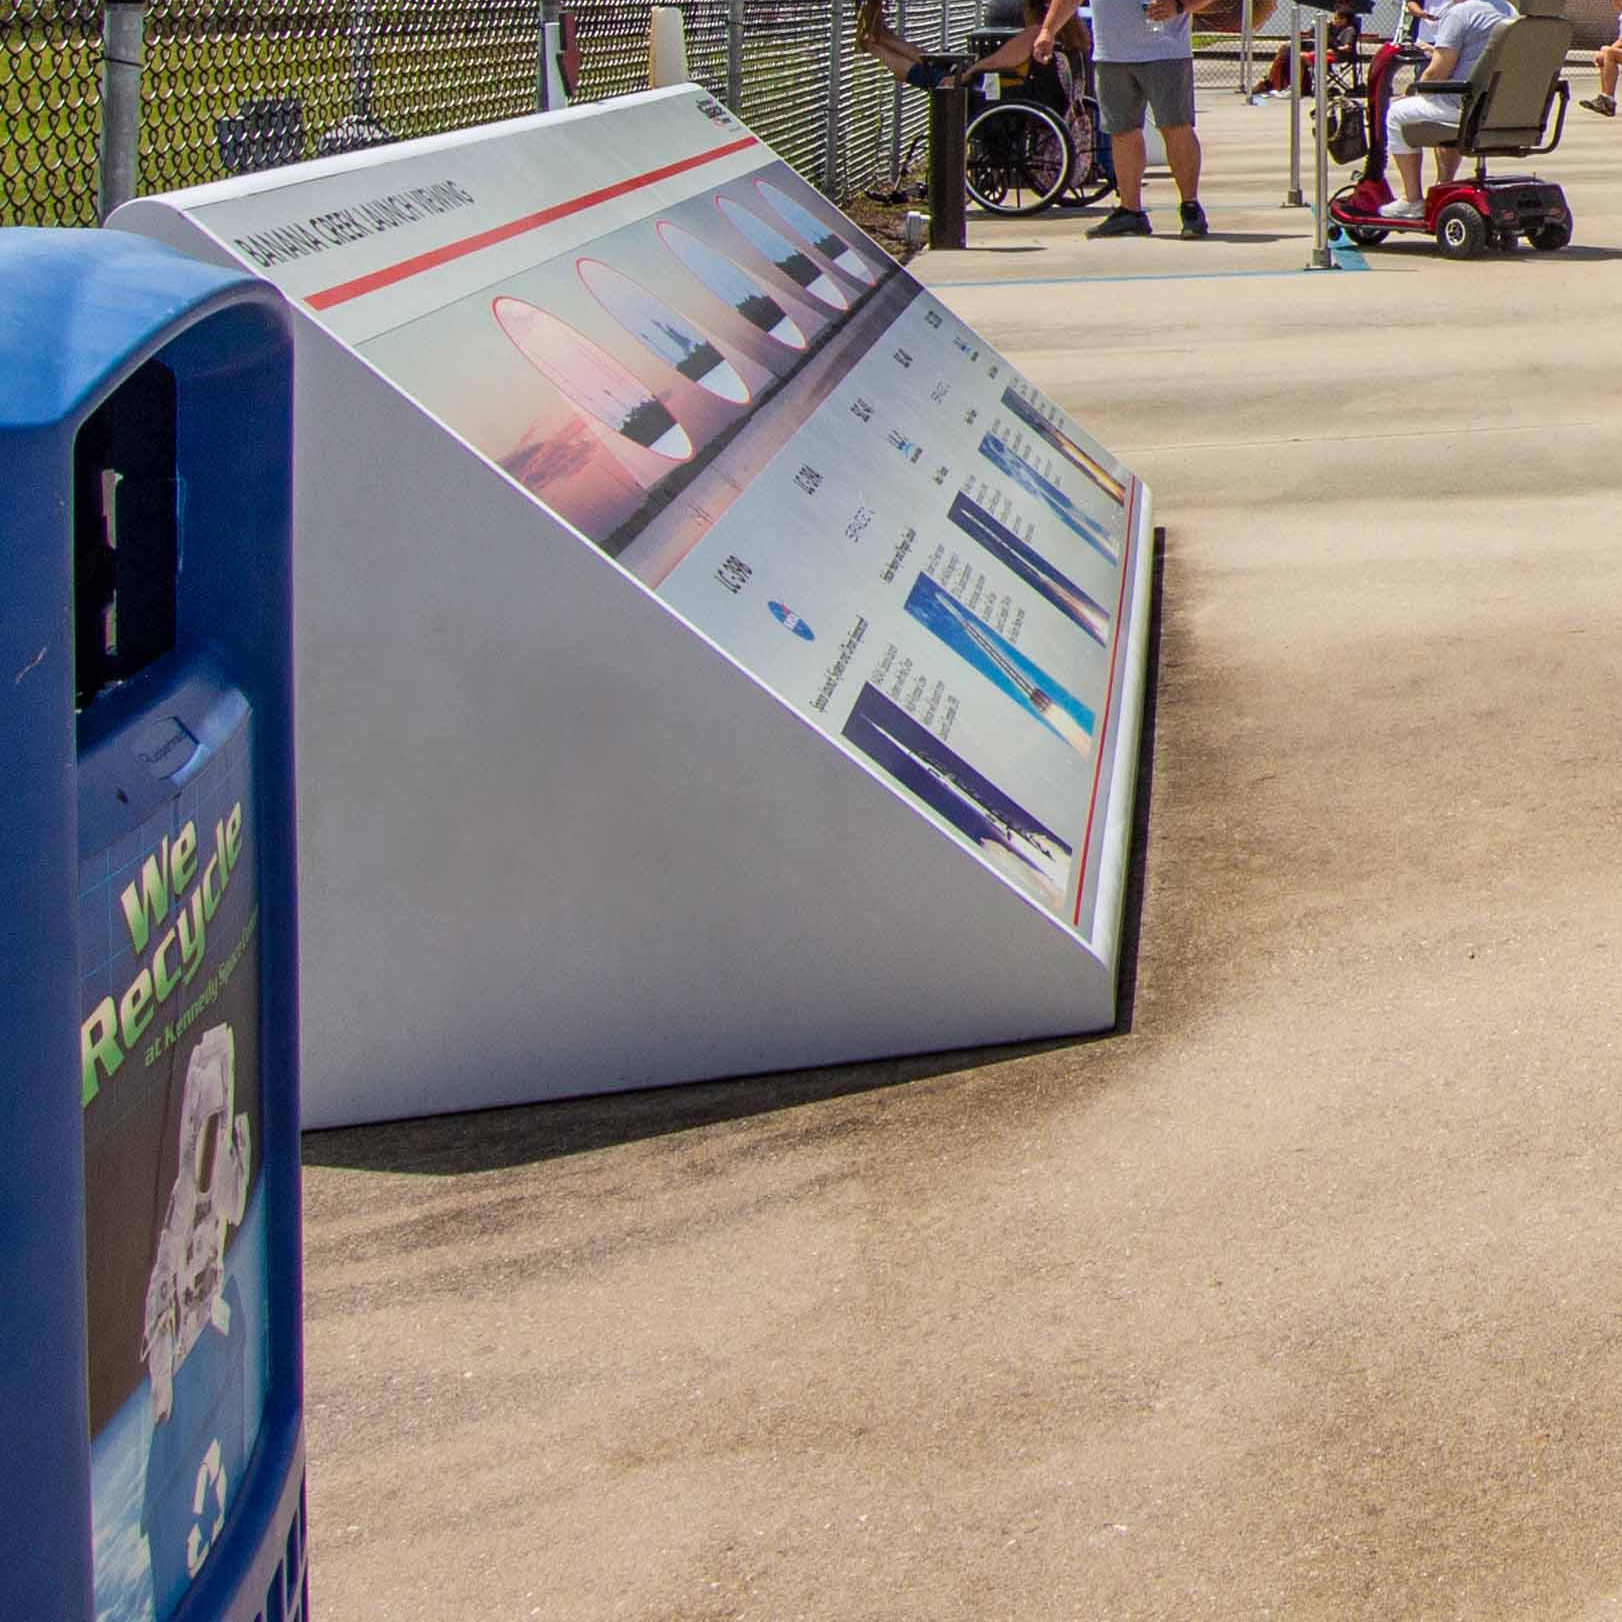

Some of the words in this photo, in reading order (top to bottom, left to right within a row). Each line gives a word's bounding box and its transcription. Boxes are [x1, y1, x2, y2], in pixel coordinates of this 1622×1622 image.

[234, 222, 328, 268] BANANA
[309, 209, 371, 246] CREEK
[352, 193, 426, 233] LAUNCH
[407, 180, 475, 214] VIEWING
[120, 820, 198, 955] We
[81, 801, 242, 1109] Recycle
[164, 976, 218, 1050] Kennedy
